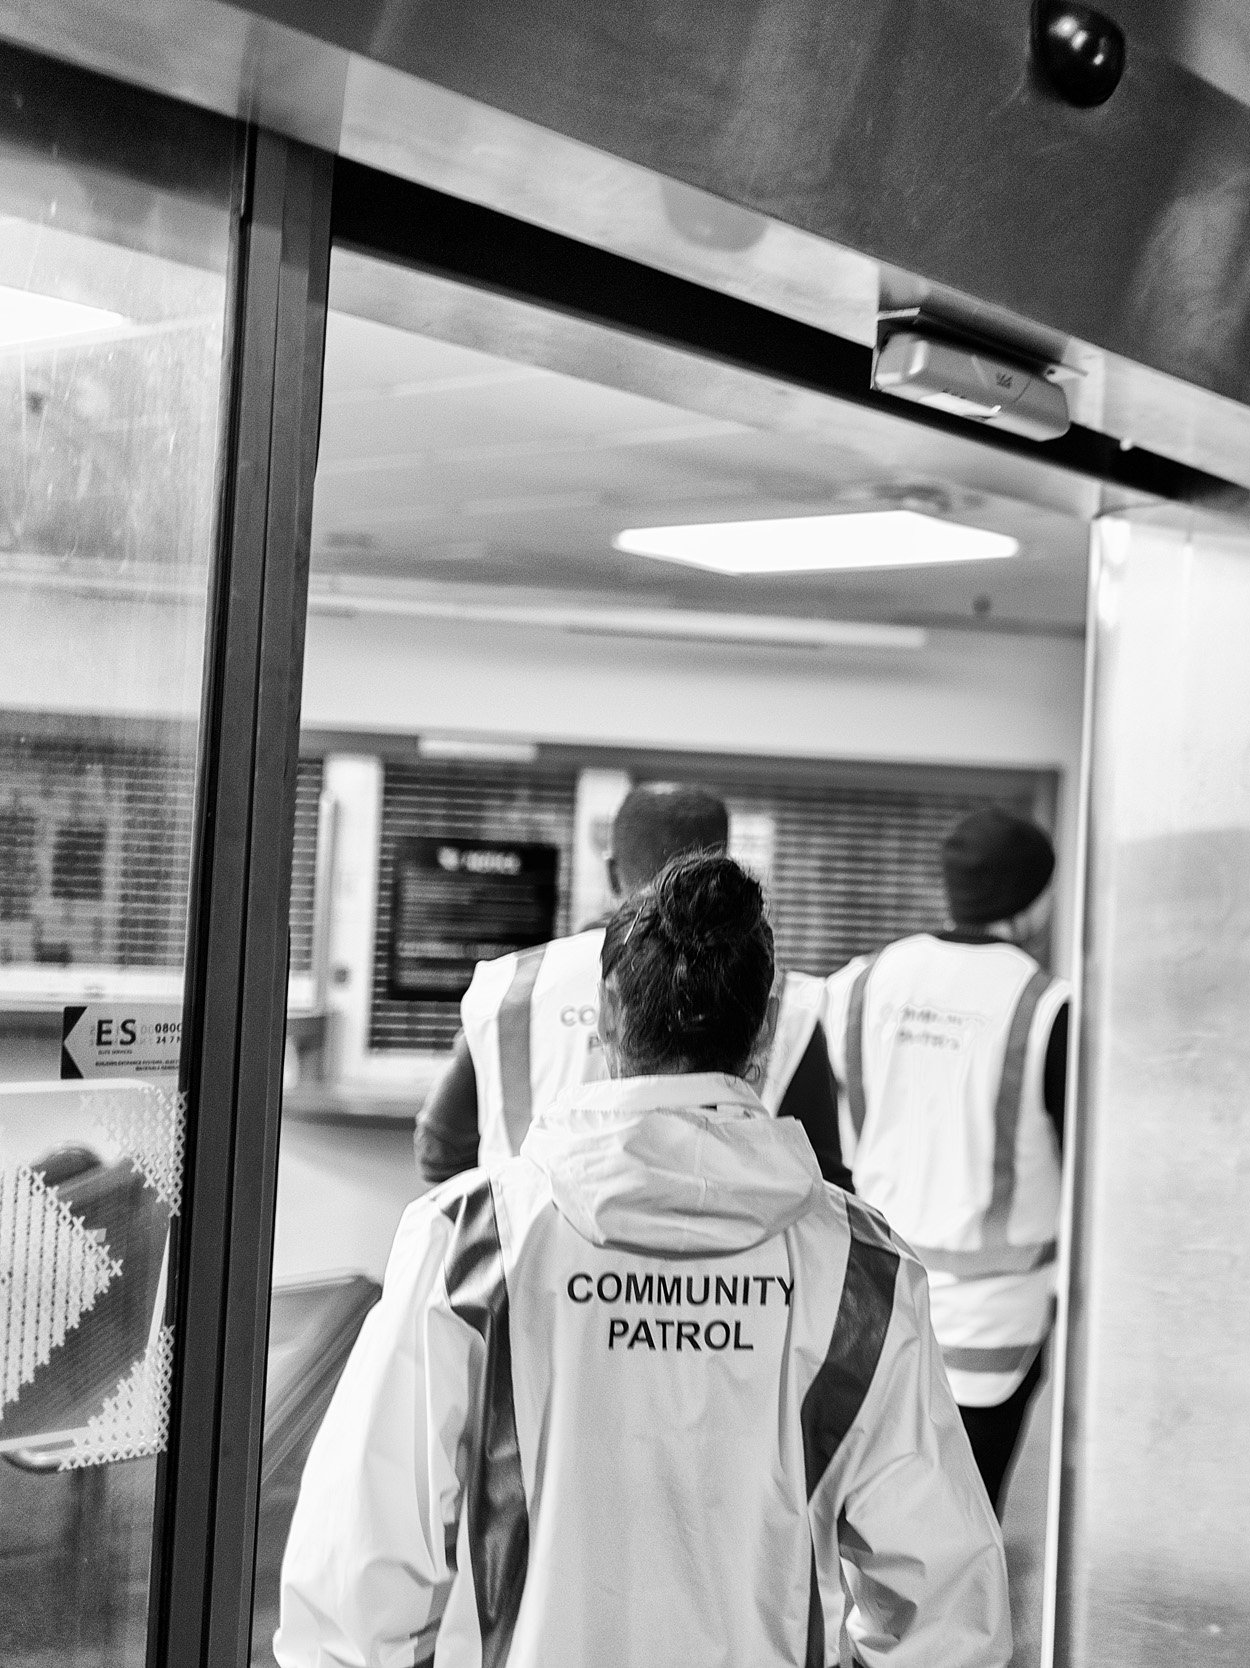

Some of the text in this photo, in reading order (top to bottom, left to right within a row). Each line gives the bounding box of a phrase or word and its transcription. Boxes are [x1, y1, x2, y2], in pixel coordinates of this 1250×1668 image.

[96, 1019, 136, 1046] ES
[567, 1272, 794, 1307] COMMUNITY
[608, 1318, 754, 1351] PATROL
